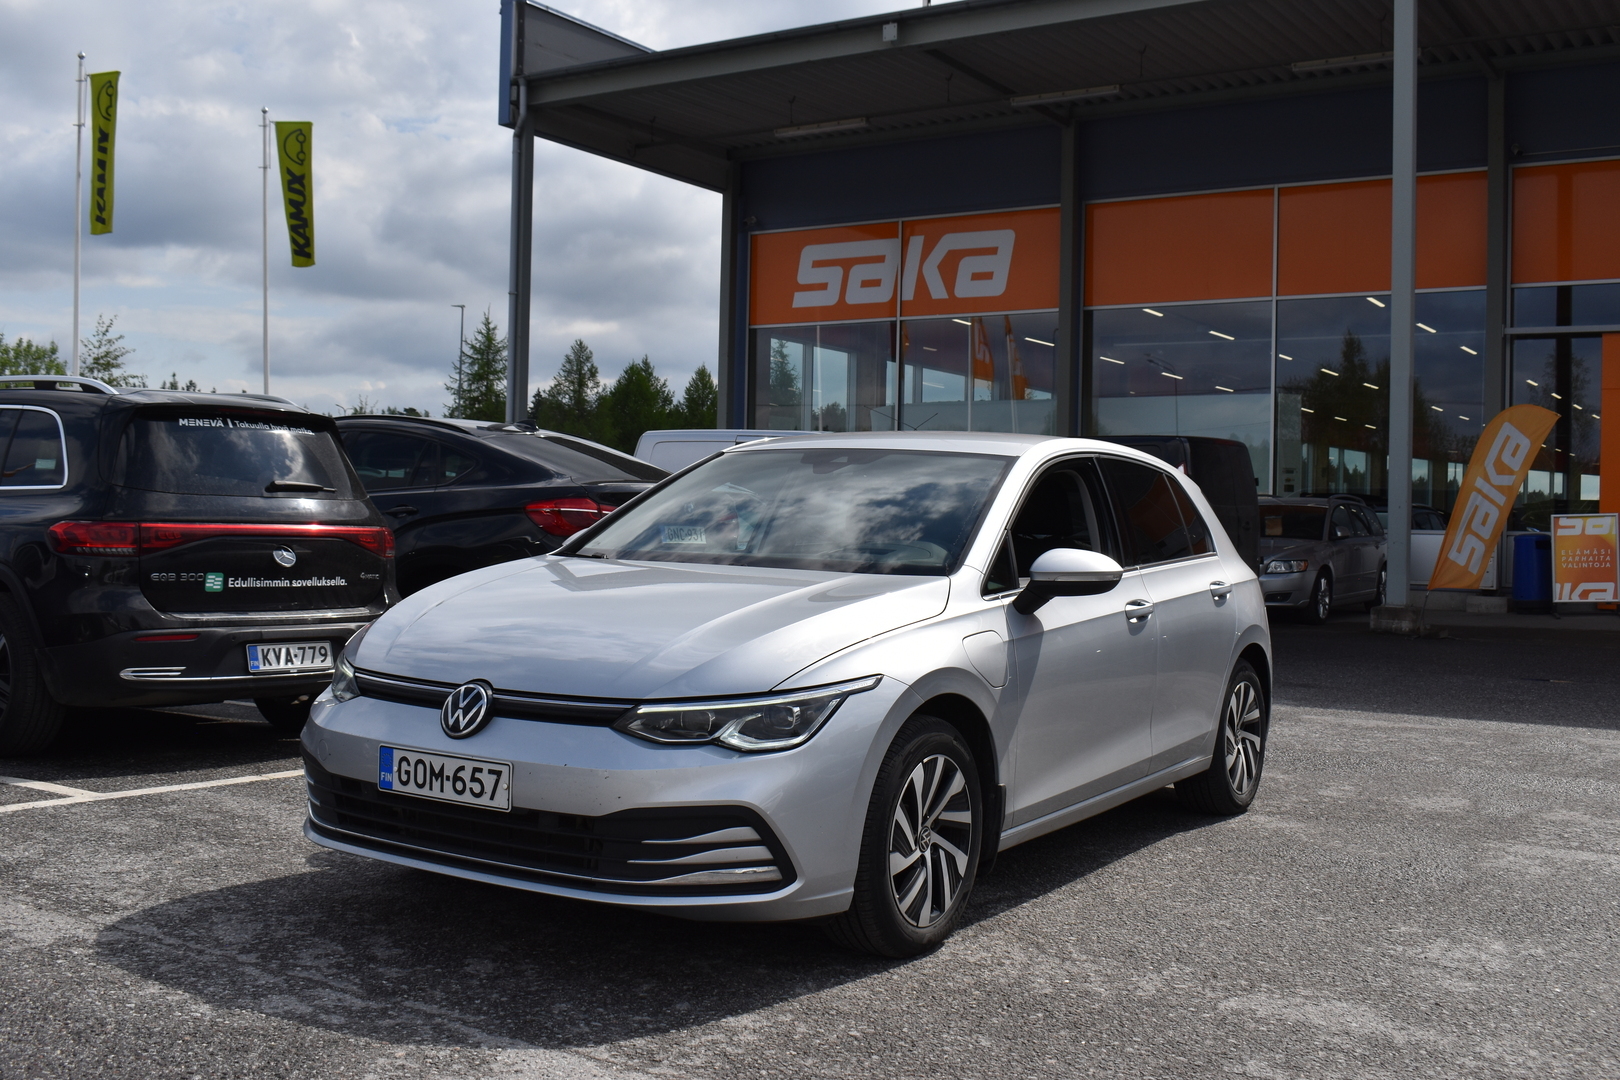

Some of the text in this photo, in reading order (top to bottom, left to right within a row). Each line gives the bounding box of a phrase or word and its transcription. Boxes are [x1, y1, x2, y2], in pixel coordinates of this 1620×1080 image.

[286, 166, 312, 259] KAMUX
[178, 417, 225, 427] MENEVÄ
[234, 420, 270, 430] Takuulla
[1561, 548, 1611, 556] ELÄMÄSI
[150, 572, 205, 582] EQB 300
[228, 576, 348, 588] Edullisimmin sovelluksella.
[261, 645, 328, 667] KVA-779
[443, 683, 487, 734] VW
[380, 771, 393, 784] FIN
[397, 756, 503, 801] GOM-657
